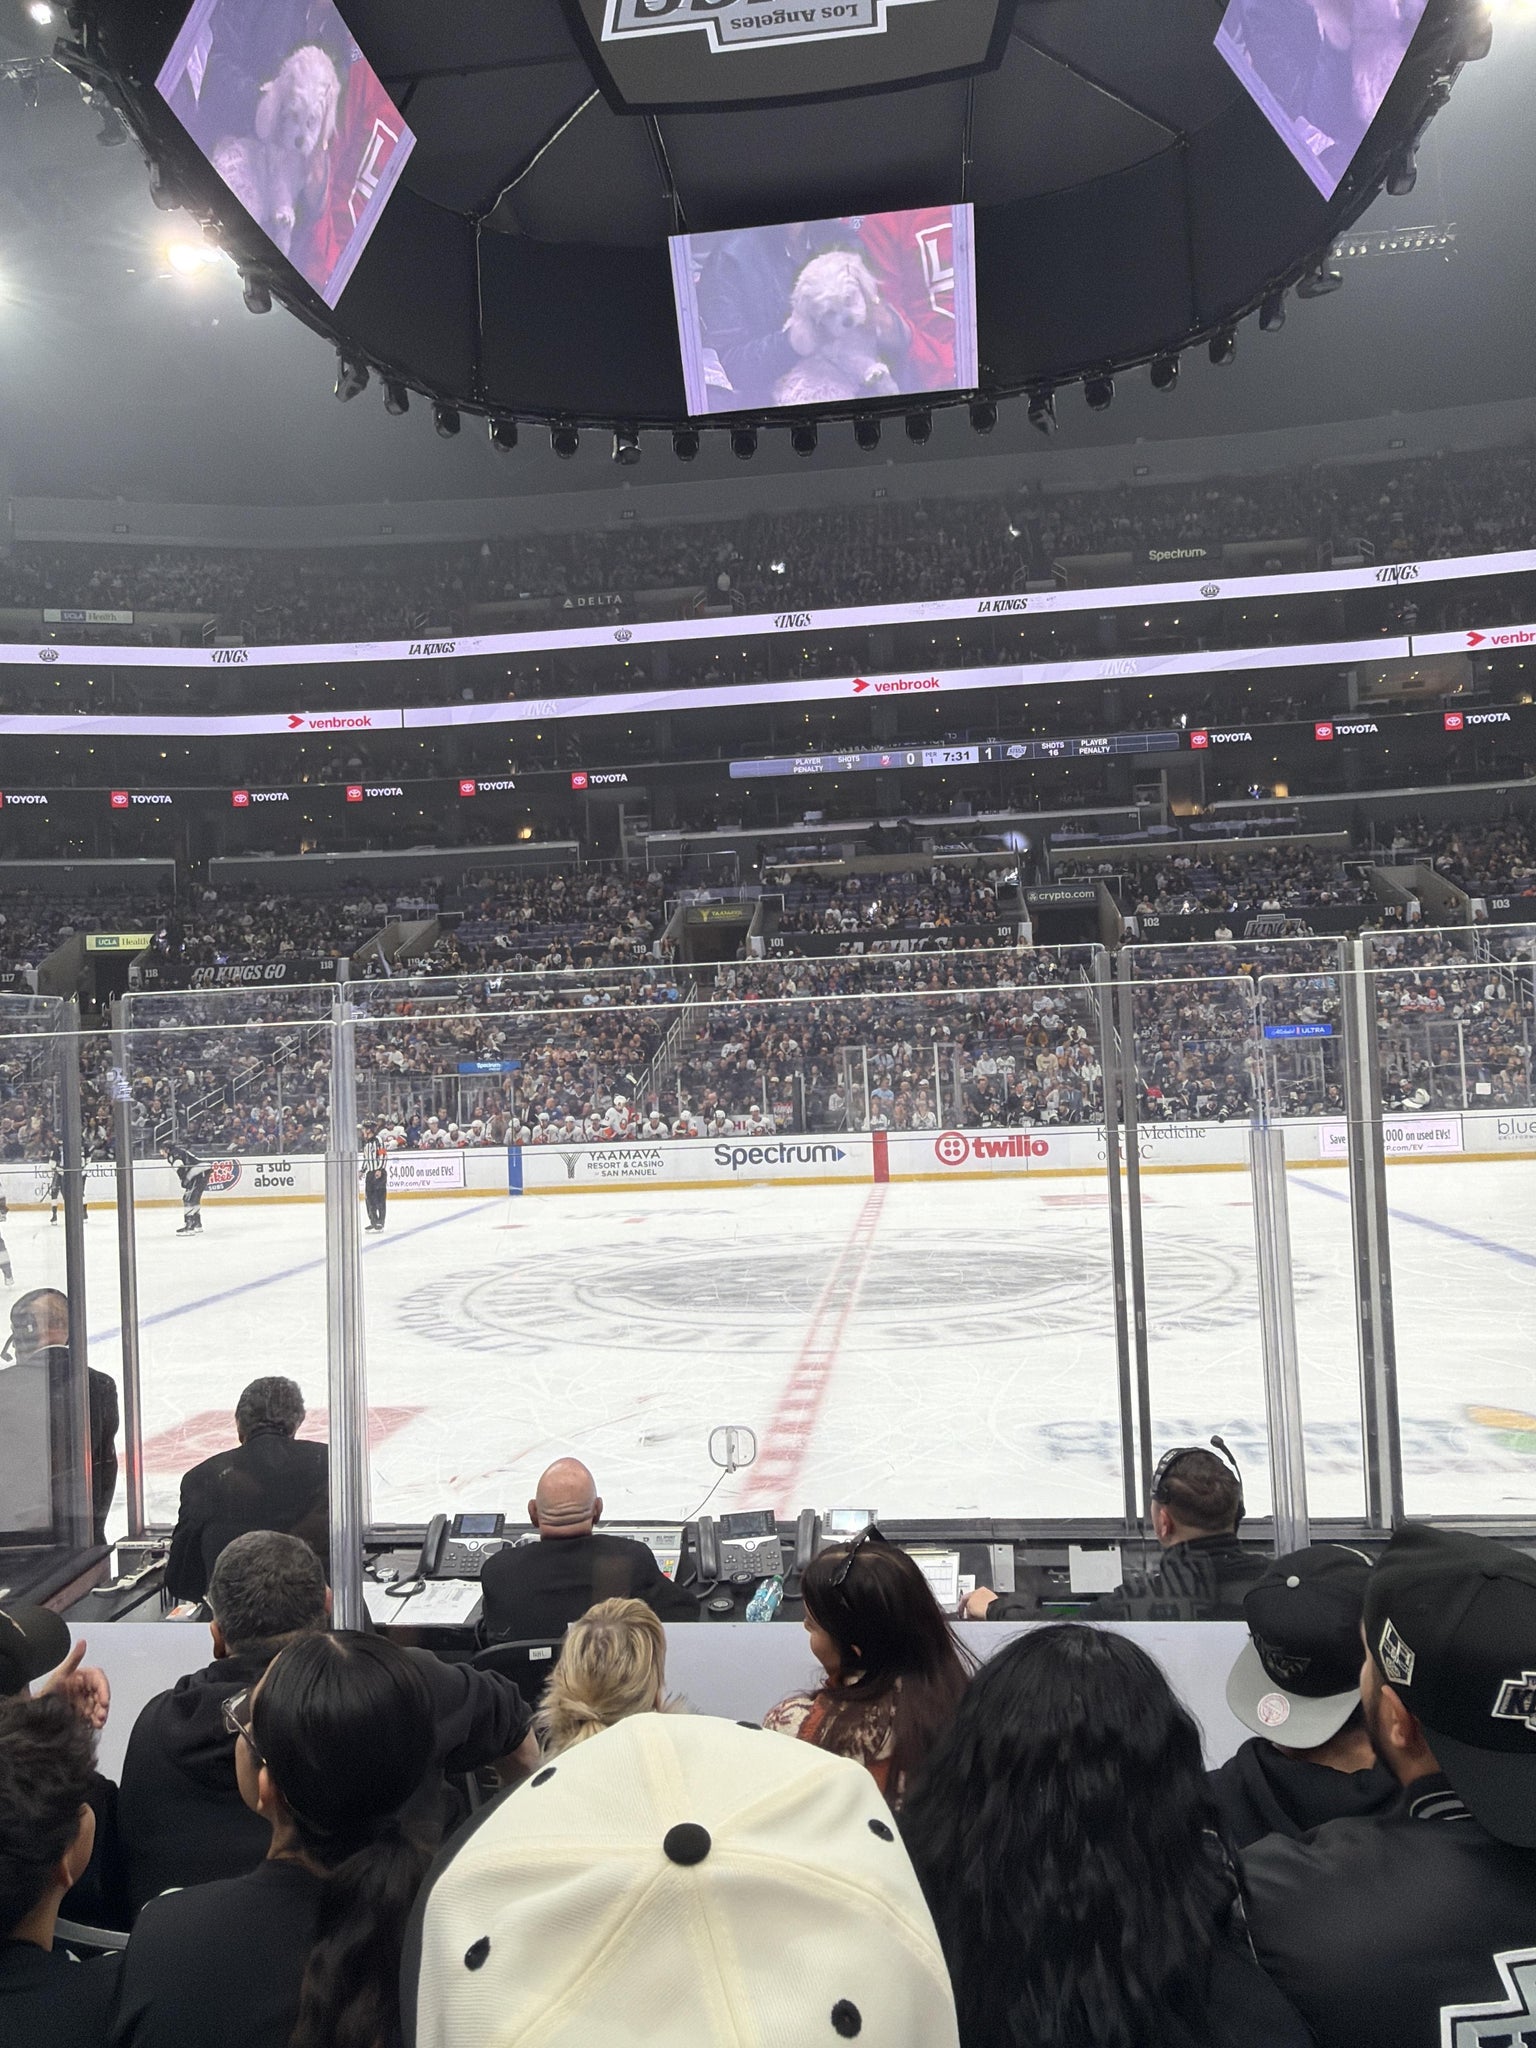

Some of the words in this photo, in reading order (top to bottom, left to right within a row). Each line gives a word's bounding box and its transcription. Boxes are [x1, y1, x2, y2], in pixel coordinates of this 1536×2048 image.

[822, 4, 858, 18] Los
[730, 8, 815, 31] Angeles
[1149, 548, 1202, 562] Spectrum
[577, 595, 622, 606] DELTA
[992, 598, 1028, 612] KINGS
[1491, 631, 1536, 645] venbr
[423, 642, 456, 656] KINGS
[874, 676, 940, 693] venbrook
[308, 714, 372, 729] venbrook
[1466, 712, 1511, 725] TOYOTA
[1336, 724, 1378, 735] TOYOTA
[1080, 738, 1108, 746] PLAYER
[1210, 732, 1252, 744] TOYOTA
[1042, 742, 1064, 750] SHOTS
[1078, 746, 1110, 755] PENALTY
[838, 755, 860, 763] SHOTS
[906, 753, 915, 765] 0
[943, 751, 970, 762] 7:31
[985, 748, 992, 760] 1
[794, 766, 824, 774] PENALTY
[590, 773, 628, 784] TOYOTA
[365, 786, 403, 798] TOYOTA
[478, 780, 516, 792] TOYOTA
[6, 794, 48, 804] TOYOTA
[131, 794, 172, 804] TOYOTA
[251, 791, 290, 802] TOYOTA
[1038, 889, 1095, 902] crypto.com
[1492, 899, 1510, 910] 103
[1384, 906, 1396, 916] 10
[1142, 917, 1160, 928] 102
[998, 926, 1012, 936] 101
[98, 938, 118, 946] UCLA
[122, 938, 148, 946] Health
[770, 938, 784, 948] 101
[632, 944, 646, 954] 119
[320, 960, 334, 970] 118
[1, 974, 15, 982] 117
[144, 969, 158, 978] 118
[194, 966, 215, 982] GO
[216, 964, 262, 980] KINGS
[264, 964, 286, 979] GO
[1140, 1124, 1206, 1140] Medicine
[1497, 1118, 1536, 1135] blue
[1330, 1134, 1346, 1144] Save
[1406, 1132, 1415, 1140] on
[1417, 1130, 1434, 1140] used
[1436, 1128, 1450, 1140] EVs!
[972, 1135, 1049, 1158] twilio
[714, 1142, 838, 1171] Spectrum
[256, 1164, 264, 1173] a
[268, 1160, 292, 1172] sub
[389, 1166, 415, 1179] $4,000
[416, 1169, 424, 1177] on
[426, 1166, 440, 1177] used
[441, 1166, 454, 1176] EVs!
[254, 1175, 294, 1187] above
